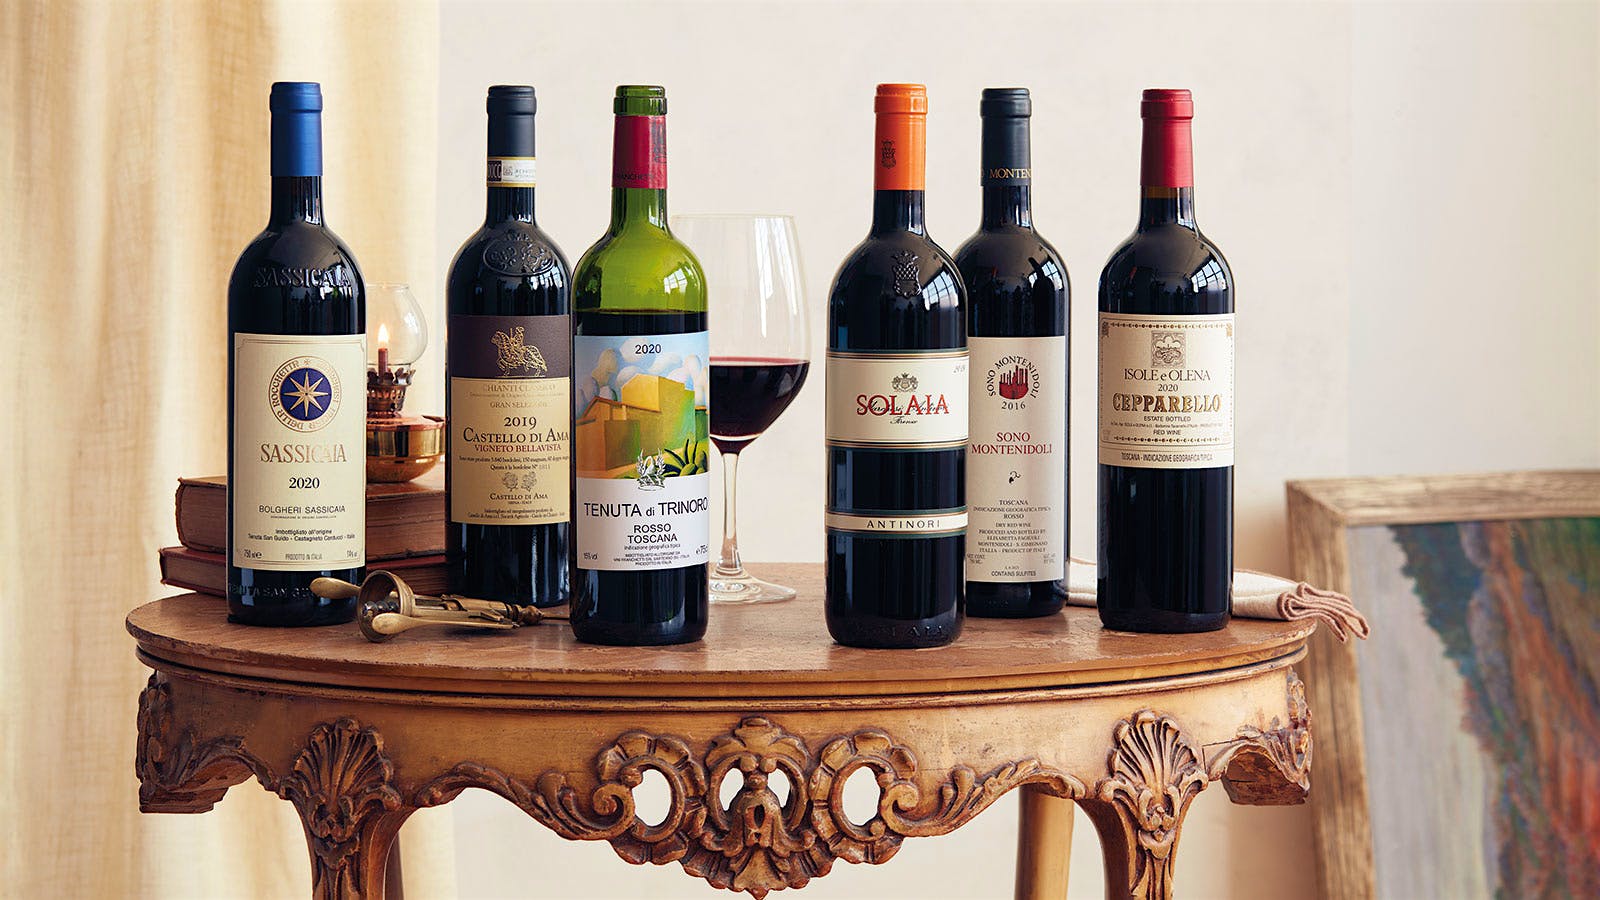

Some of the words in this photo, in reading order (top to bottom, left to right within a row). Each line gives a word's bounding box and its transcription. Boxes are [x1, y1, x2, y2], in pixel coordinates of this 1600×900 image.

[254, 265, 351, 288] SASSICAIA
[635, 344, 662, 355] 2020
[986, 369, 996, 397] SONO
[994, 355, 1041, 399] MONTENIDOLI
[1124, 367, 1159, 381] ISOLE
[1160, 372, 1168, 381] e
[1168, 368, 1211, 382] OLENA
[1158, 383, 1179, 392] 2020
[856, 393, 949, 416] SOLAIA
[1001, 401, 1025, 411] 2016
[1112, 392, 1222, 413] CEPPARELLO
[504, 416, 537, 430] 2019
[463, 427, 526, 443] CASTELLO
[530, 433, 542, 442] DI
[546, 428, 569, 441] AMA
[996, 432, 1031, 443] SONO
[260, 443, 347, 463] SASSICAIA
[474, 444, 514, 453] VIGNETO
[516, 443, 561, 453] BELLAVISTA
[971, 443, 1052, 455] MONTENIDOLI
[1121, 452, 1140, 461] TOSCANA
[1143, 453, 1172, 463] INDICAZIONE
[1172, 454, 1200, 463] GEOGRAFICA
[288, 477, 320, 489] 2020
[258, 504, 302, 514] BOLGHERI
[304, 505, 346, 514] SASSICAIA
[583, 502, 642, 517] TENUTA
[645, 506, 655, 516] di
[658, 496, 708, 516] TRINORO
[633, 523, 671, 533] ROSSO
[866, 519, 941, 529] ANTINORI
[627, 533, 678, 544] TOSCANA
